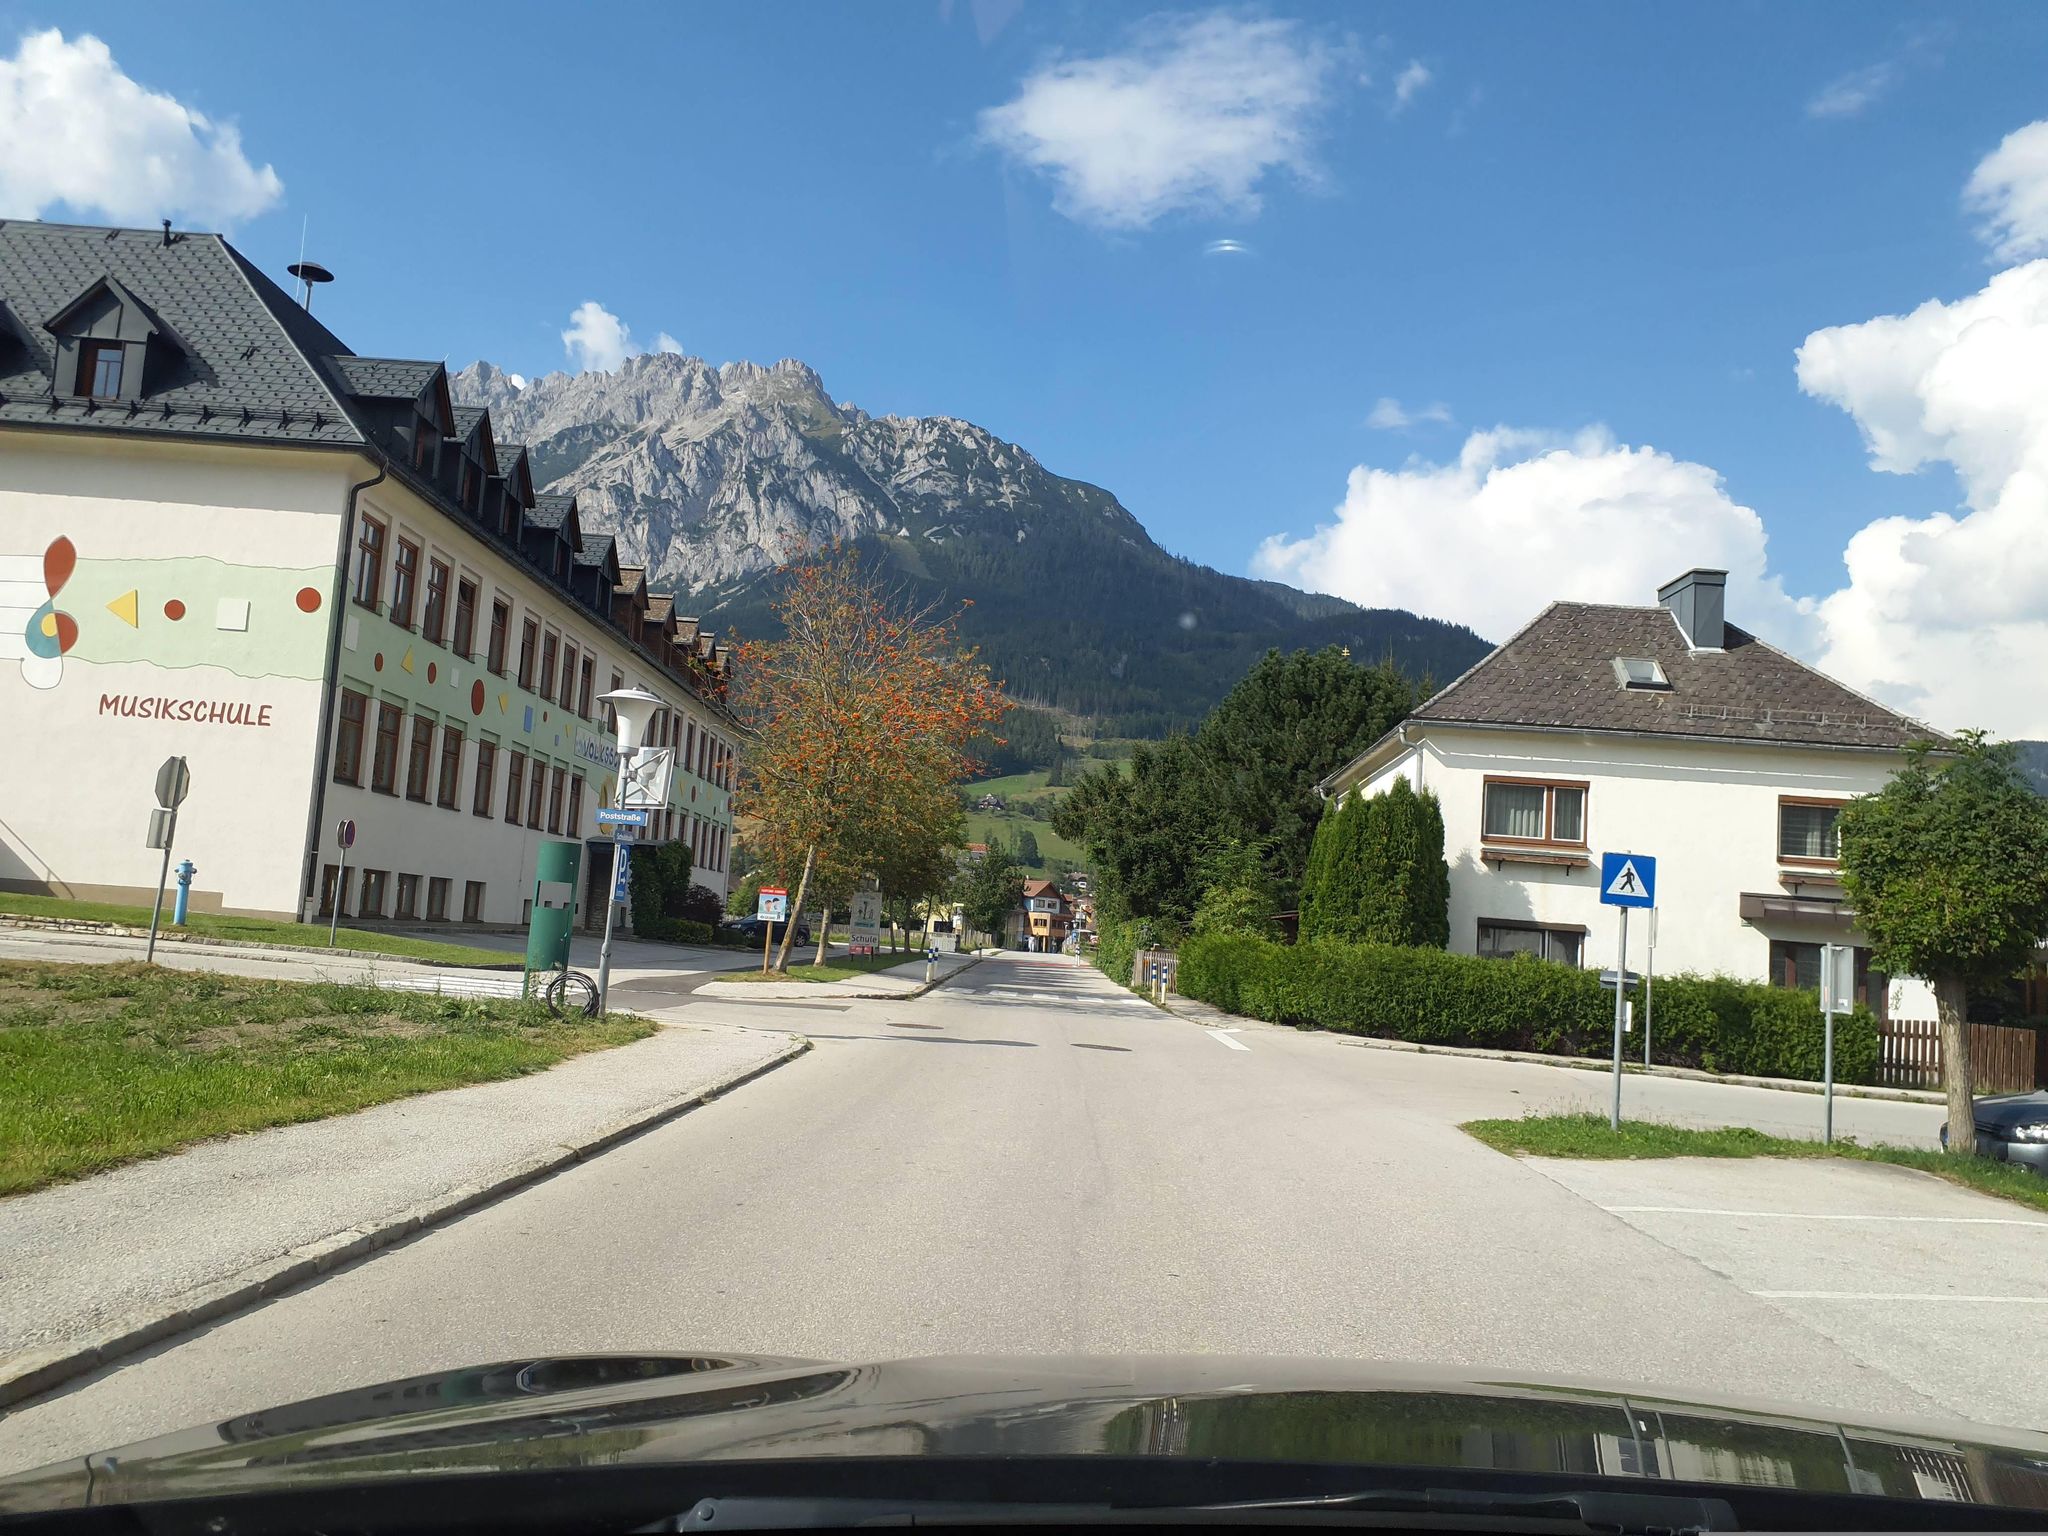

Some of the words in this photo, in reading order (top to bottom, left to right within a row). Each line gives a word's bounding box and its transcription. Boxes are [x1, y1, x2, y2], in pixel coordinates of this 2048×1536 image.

[99, 693, 273, 727] MUSIKSCHULE
[600, 811, 641, 822] Poststraße
[618, 848, 627, 885] P
[851, 934, 877, 944] Schule
